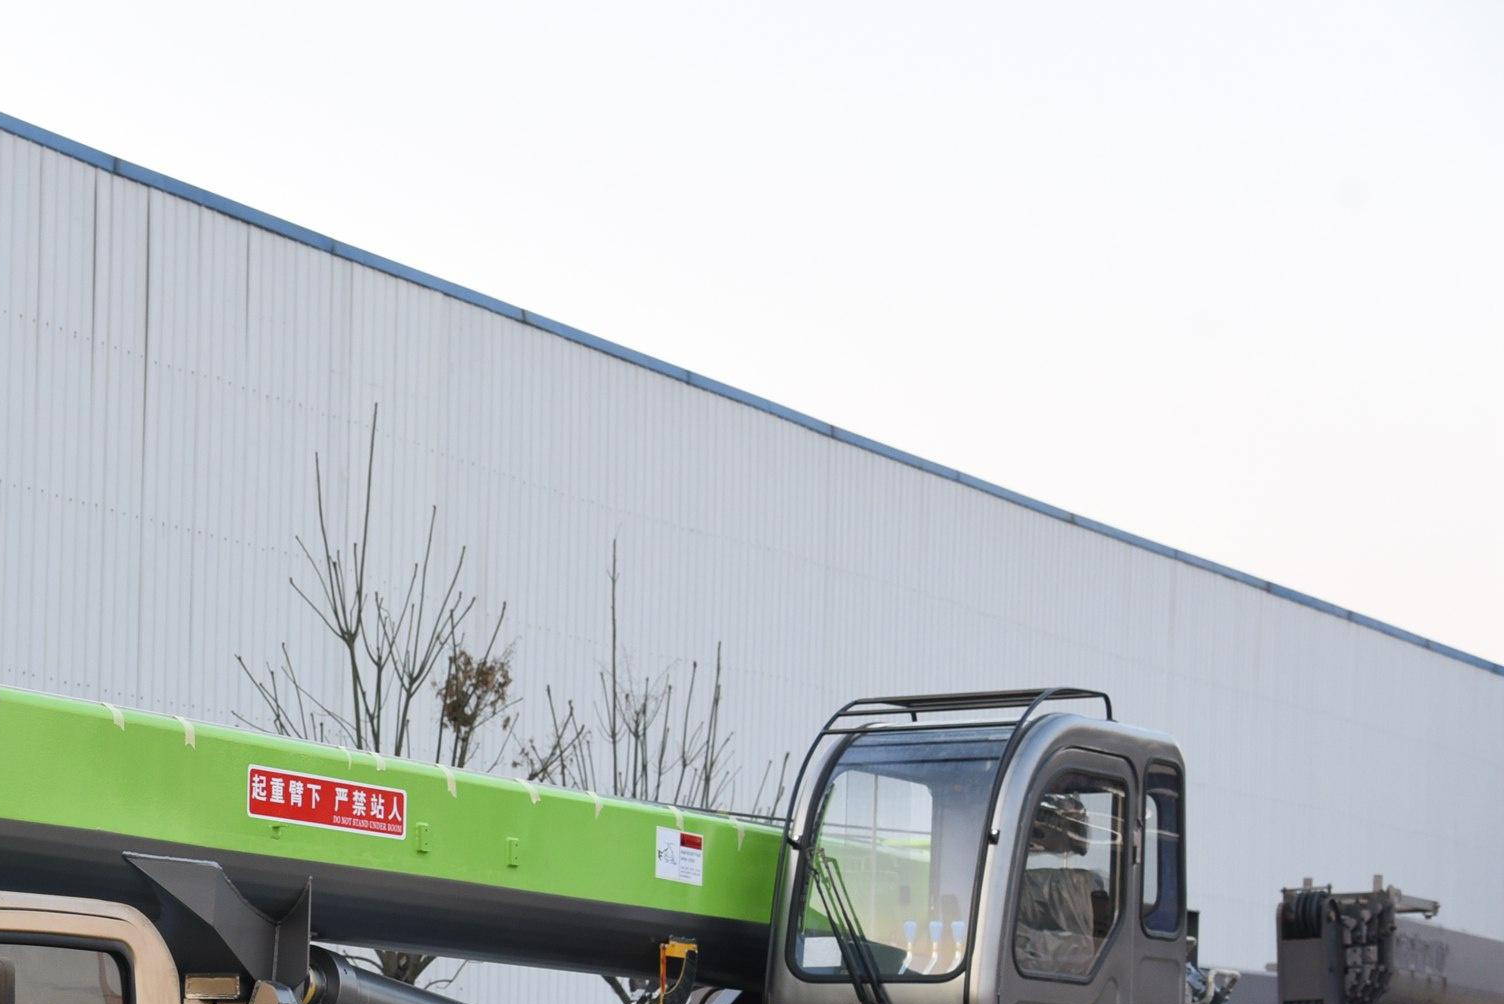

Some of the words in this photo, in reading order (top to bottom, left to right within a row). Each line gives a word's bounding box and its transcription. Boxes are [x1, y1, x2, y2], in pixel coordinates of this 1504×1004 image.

[251, 774, 322, 809] 起重臂下
[334, 787, 402, 822] 严禁站人
